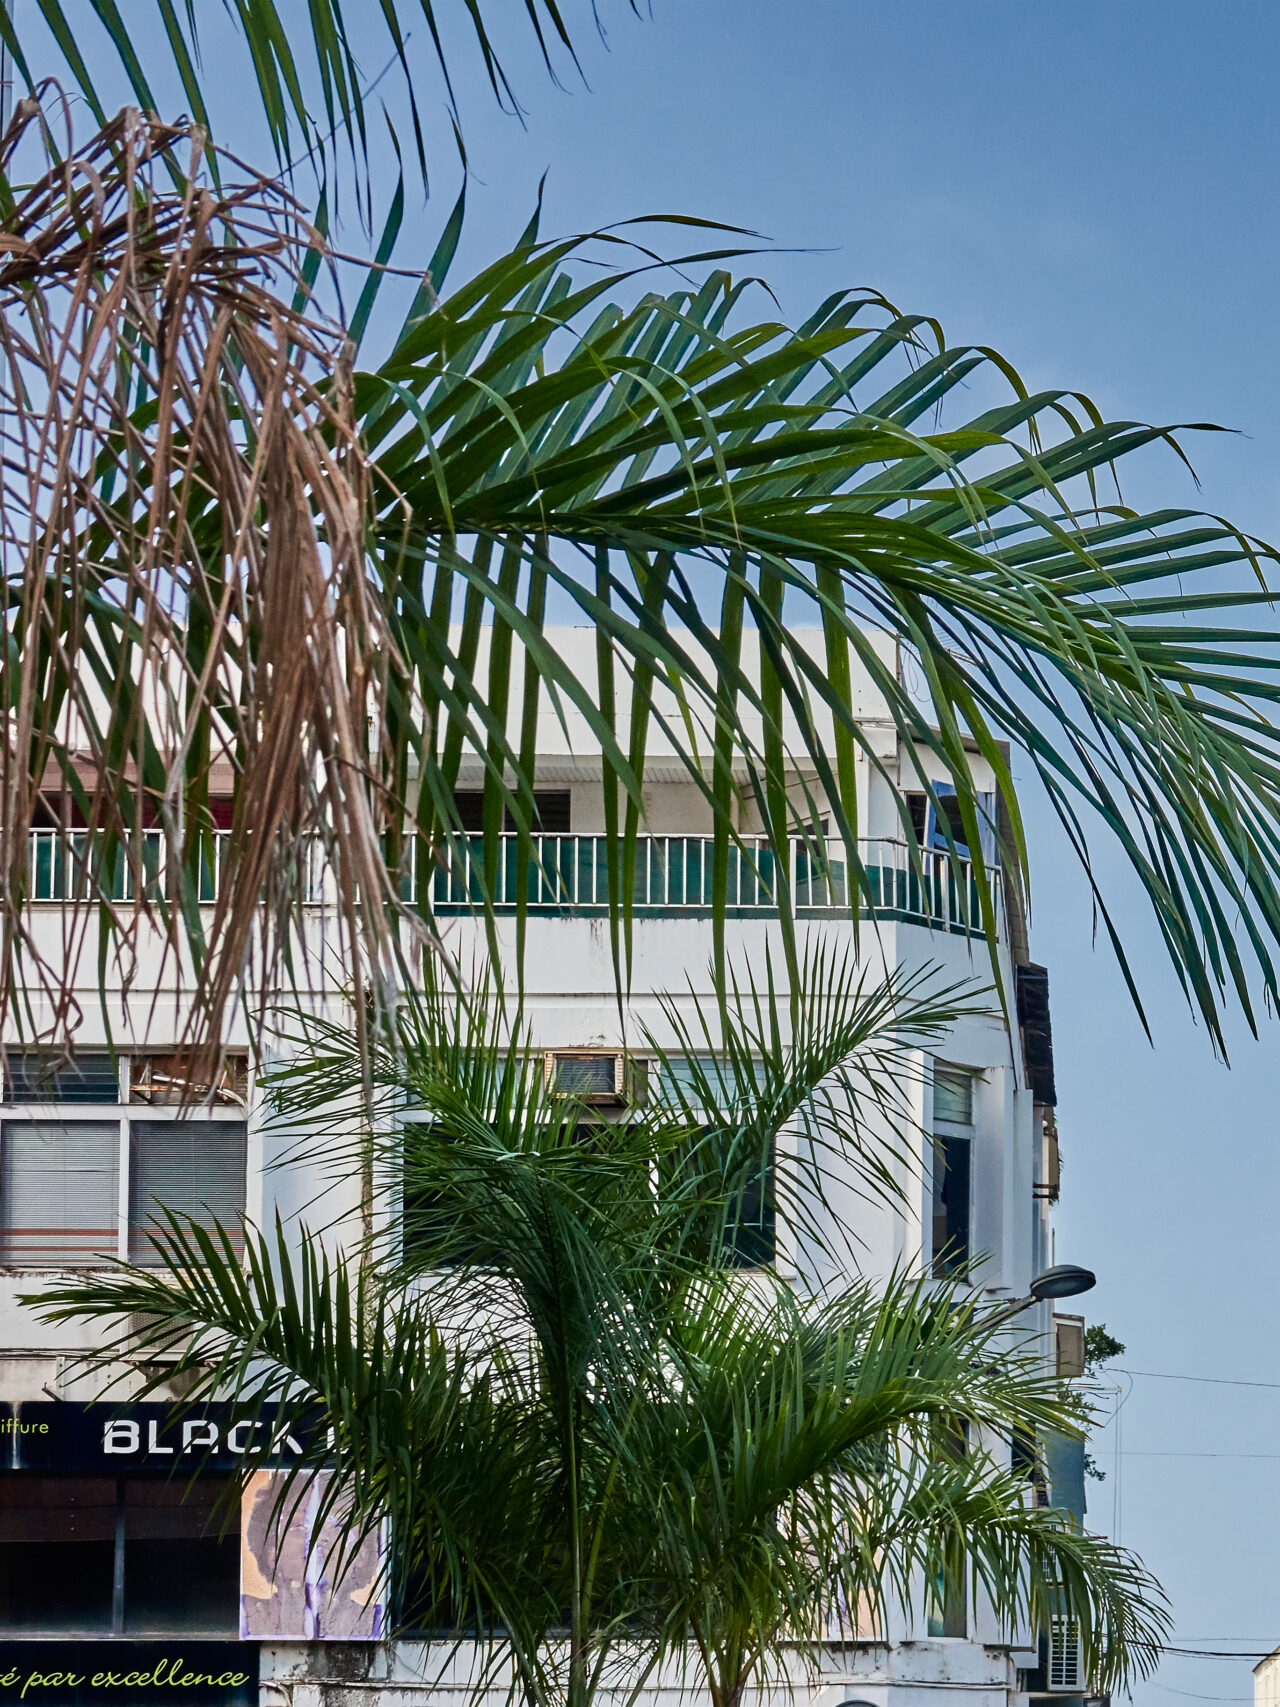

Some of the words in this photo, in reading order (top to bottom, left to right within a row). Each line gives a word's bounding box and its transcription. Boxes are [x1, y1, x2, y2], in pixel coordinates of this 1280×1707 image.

[0, 1418, 50, 1434] iffure
[103, 1419, 303, 1455] BLACK
[20, 1670, 85, 1699] par
[91, 1658, 250, 1688] excellence
